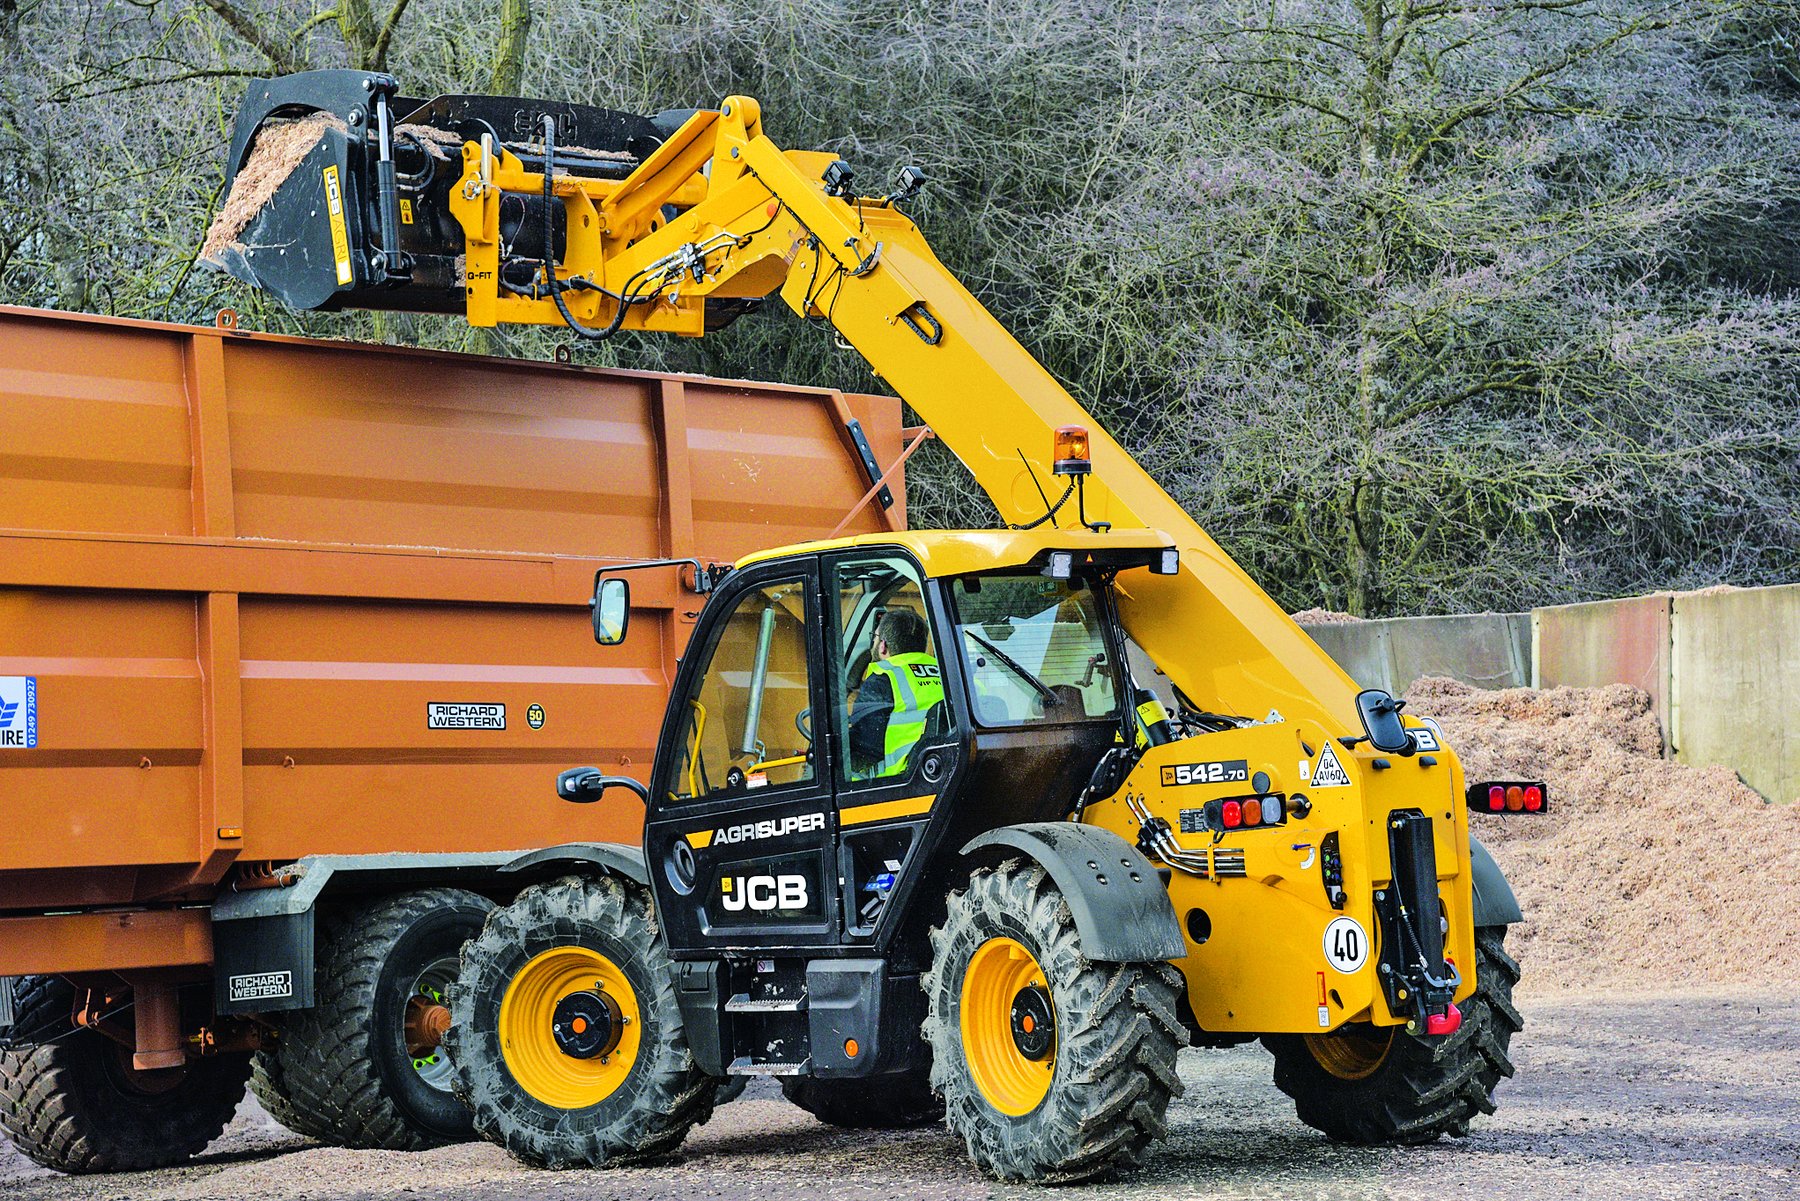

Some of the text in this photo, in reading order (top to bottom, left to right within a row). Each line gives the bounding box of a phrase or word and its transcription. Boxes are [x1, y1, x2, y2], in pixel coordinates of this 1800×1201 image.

[326, 170, 348, 262] JCB AGRI
[467, 271, 492, 280] Q-FIT
[910, 664, 941, 677] JC
[26, 679, 37, 746] 01249 730927
[435, 705, 498, 716] RICHARD
[529, 710, 543, 721] 50
[432, 716, 502, 727] WESTERN
[0, 729, 24, 746] IRE
[713, 812, 826, 846] AGRISUPER
[721, 874, 809, 911] JCB
[1334, 928, 1359, 962] 40
[235, 974, 285, 989] RICHARD
[234, 984, 288, 998] WESTERN
